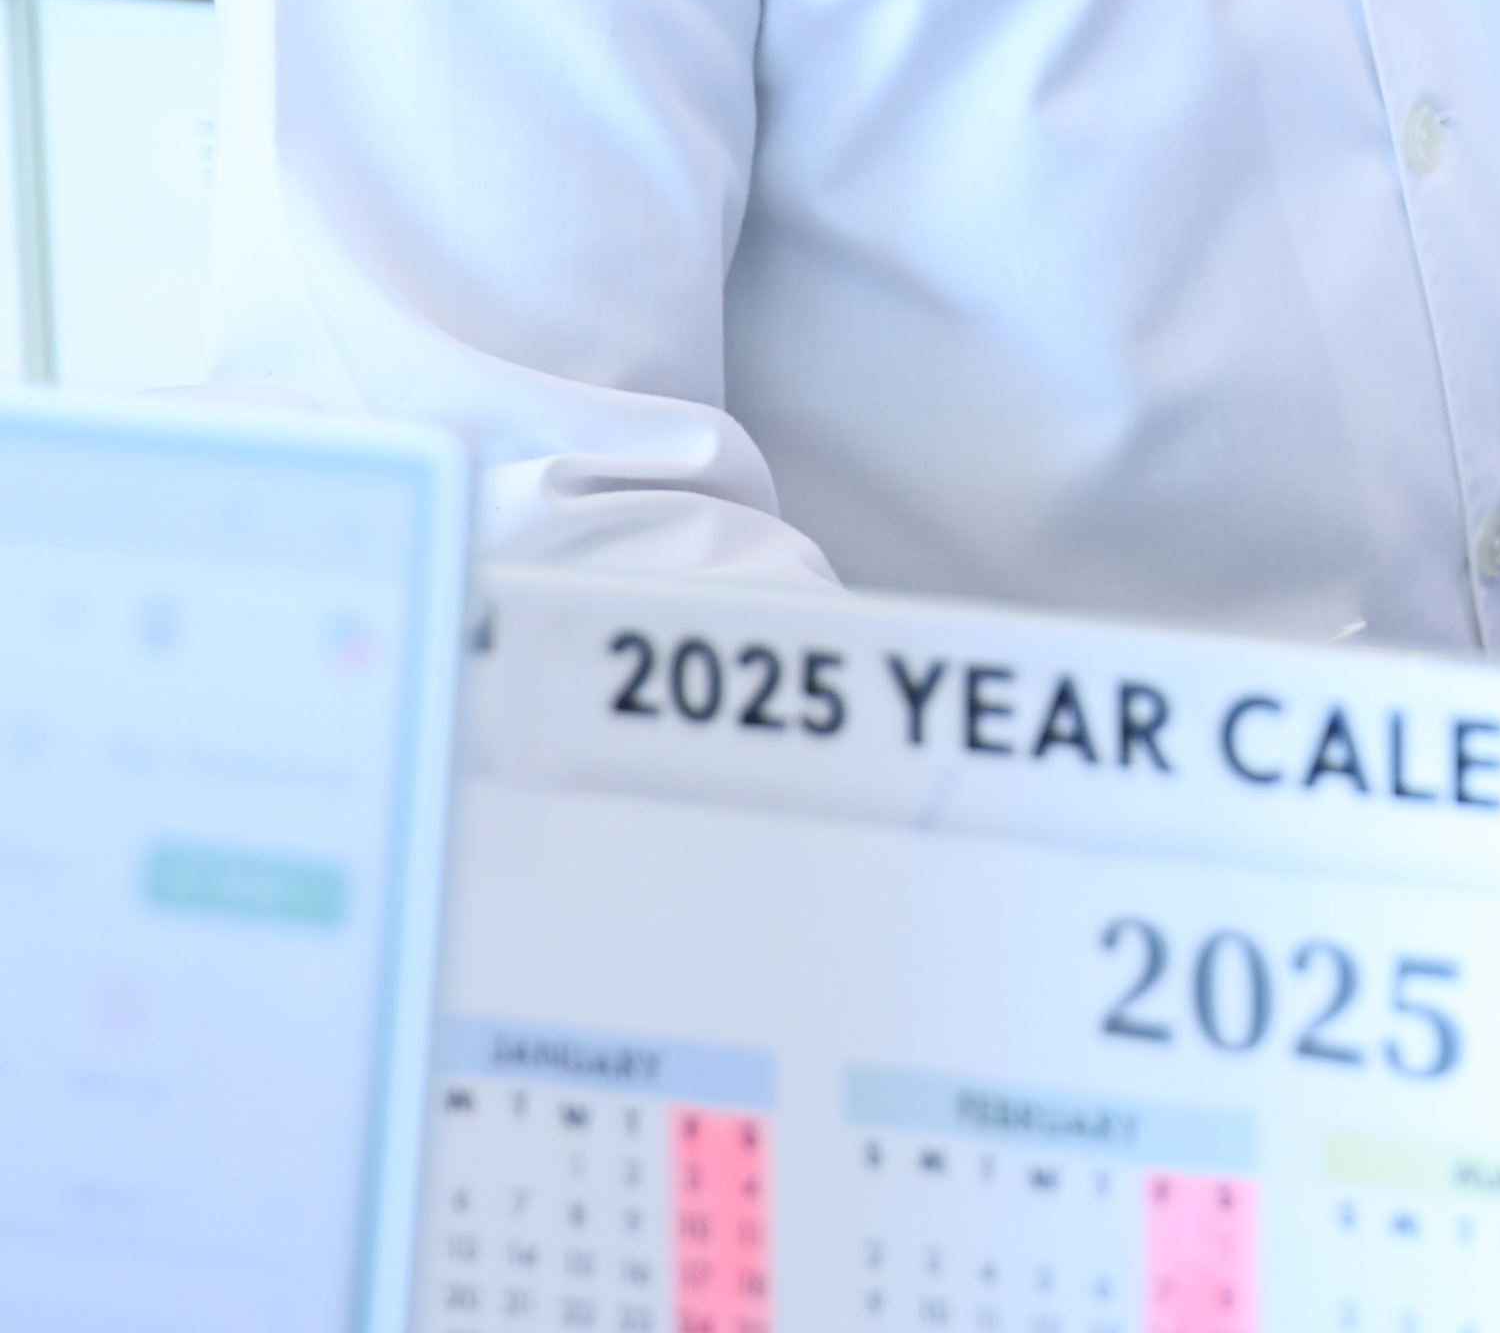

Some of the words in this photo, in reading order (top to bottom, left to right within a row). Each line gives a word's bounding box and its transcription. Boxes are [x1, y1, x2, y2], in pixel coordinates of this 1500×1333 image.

[606, 630, 848, 735] 2025
[884, 651, 1178, 775] YEAR
[1100, 916, 1466, 1083] 2025
[490, 1032, 663, 1083] JANUARY
[955, 1086, 1139, 1144] FEBRUARY
